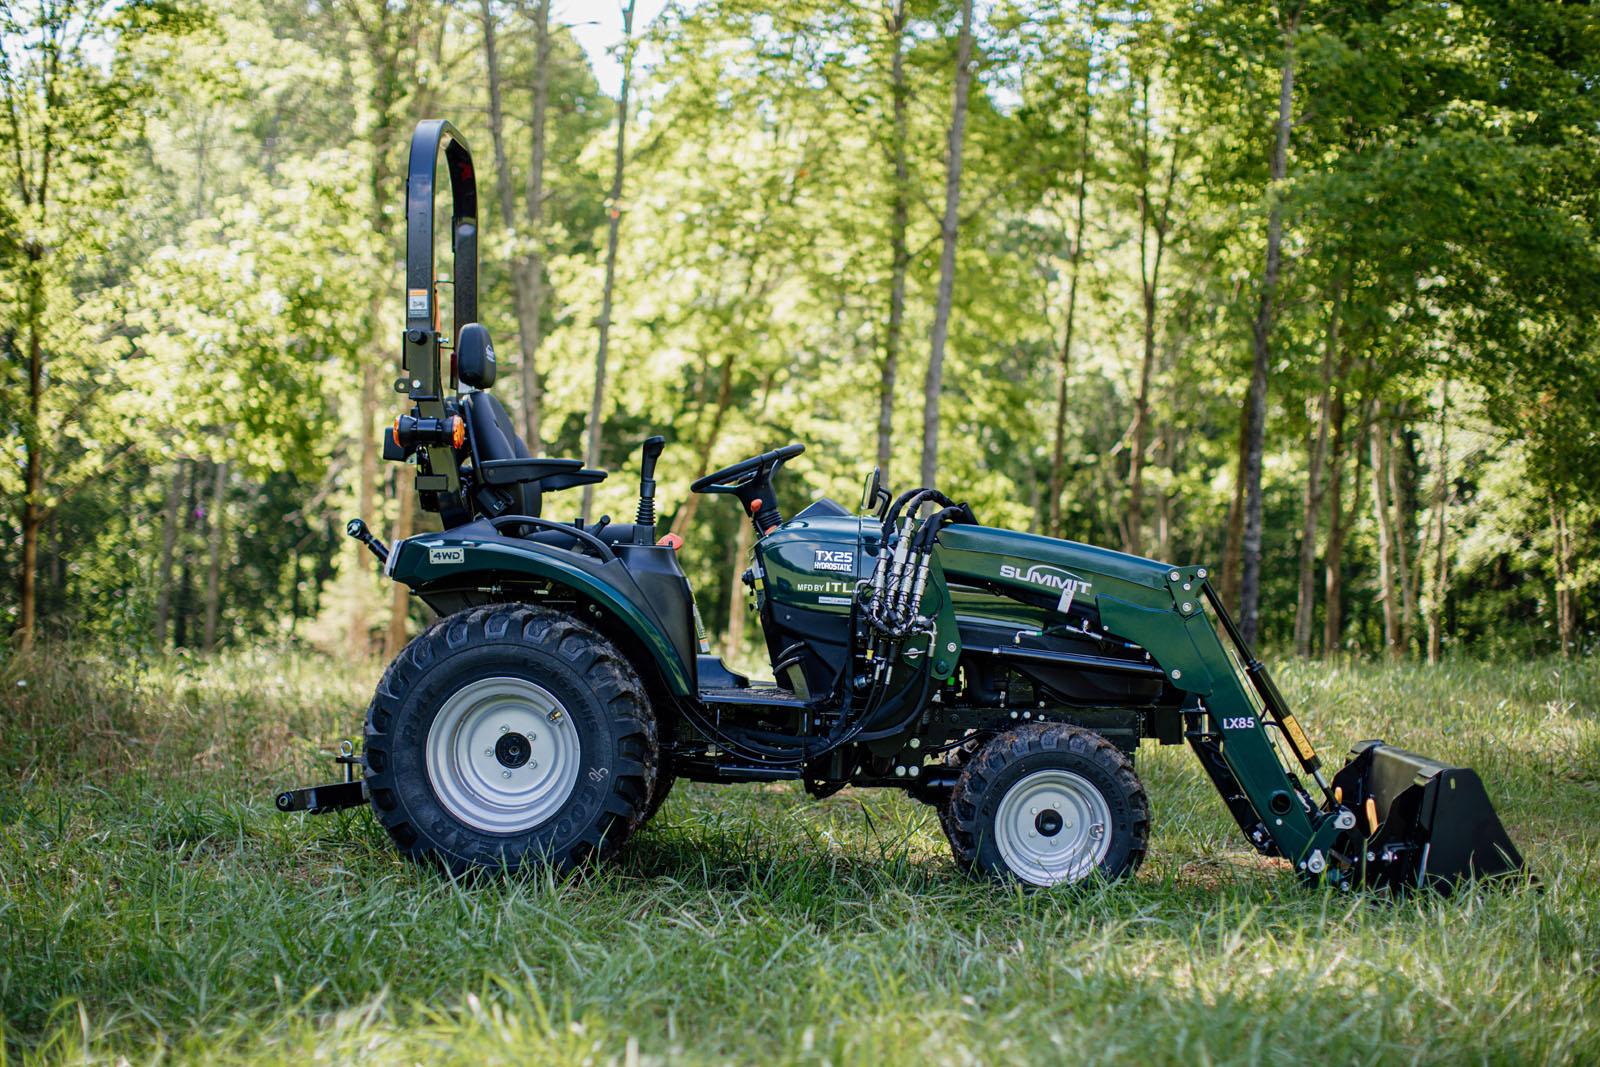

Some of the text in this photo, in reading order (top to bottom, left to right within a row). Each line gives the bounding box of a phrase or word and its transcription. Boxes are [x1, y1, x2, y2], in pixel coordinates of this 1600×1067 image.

[433, 551, 461, 560] 4WD
[815, 550, 853, 563] TX25
[814, 561, 853, 572] HYDROSTATIC
[1000, 565, 1092, 595] SUMMIT
[797, 583, 813, 591] MFD
[825, 581, 853, 593] ITL
[1222, 716, 1255, 730] LX85
